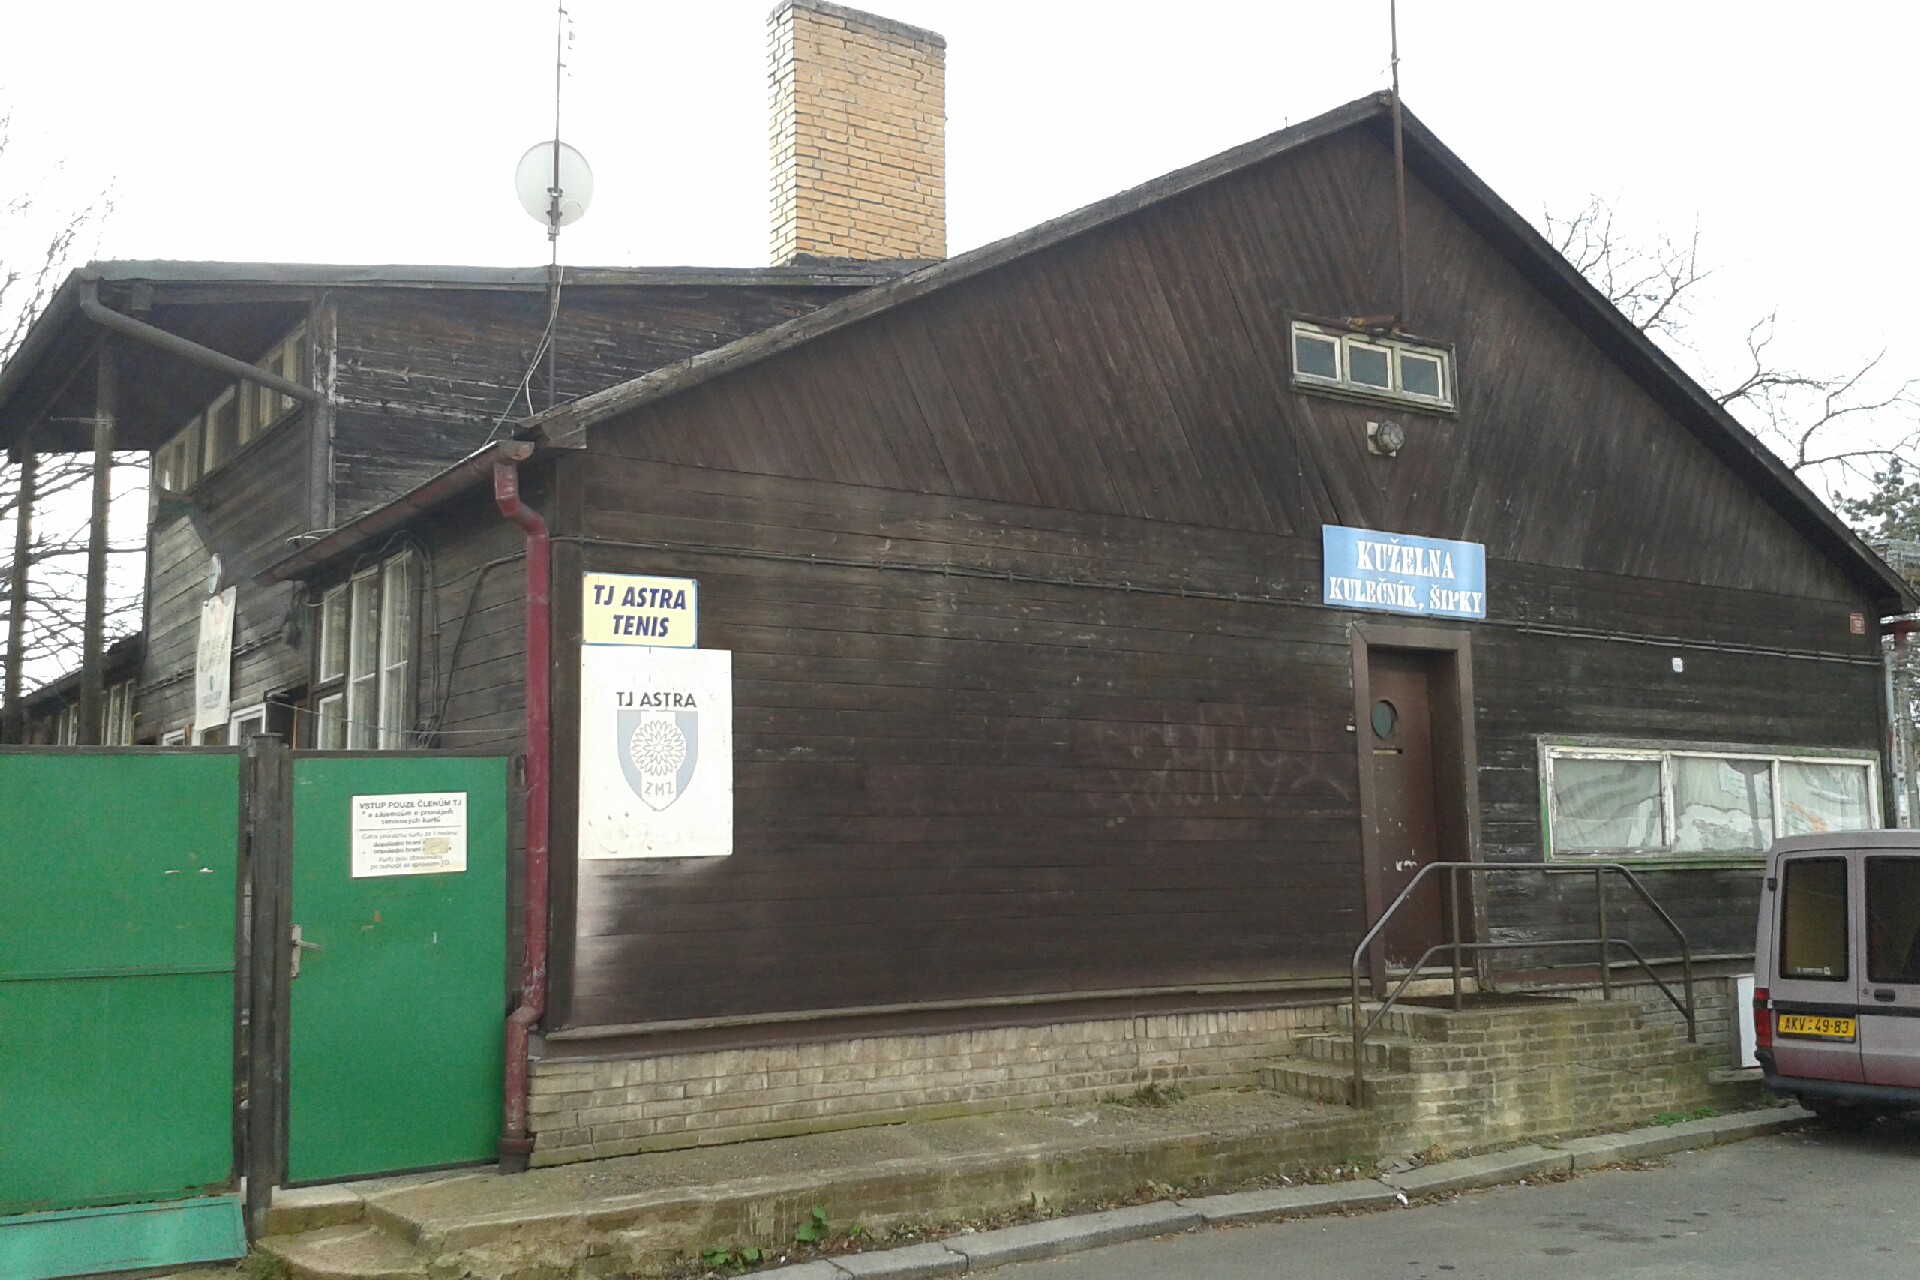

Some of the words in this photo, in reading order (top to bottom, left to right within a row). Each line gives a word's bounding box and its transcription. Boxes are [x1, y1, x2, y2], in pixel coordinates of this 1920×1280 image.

[1357, 538, 1455, 579] KUŽELNA
[594, 584, 615, 606] TJ
[621, 586, 687, 610] ASTRA
[1429, 584, 1482, 613] ŠIPKY
[613, 614, 669, 637] TENIS
[616, 691, 633, 707] TJ
[640, 692, 697, 708] ASTRA
[359, 801, 387, 809] VSTUP
